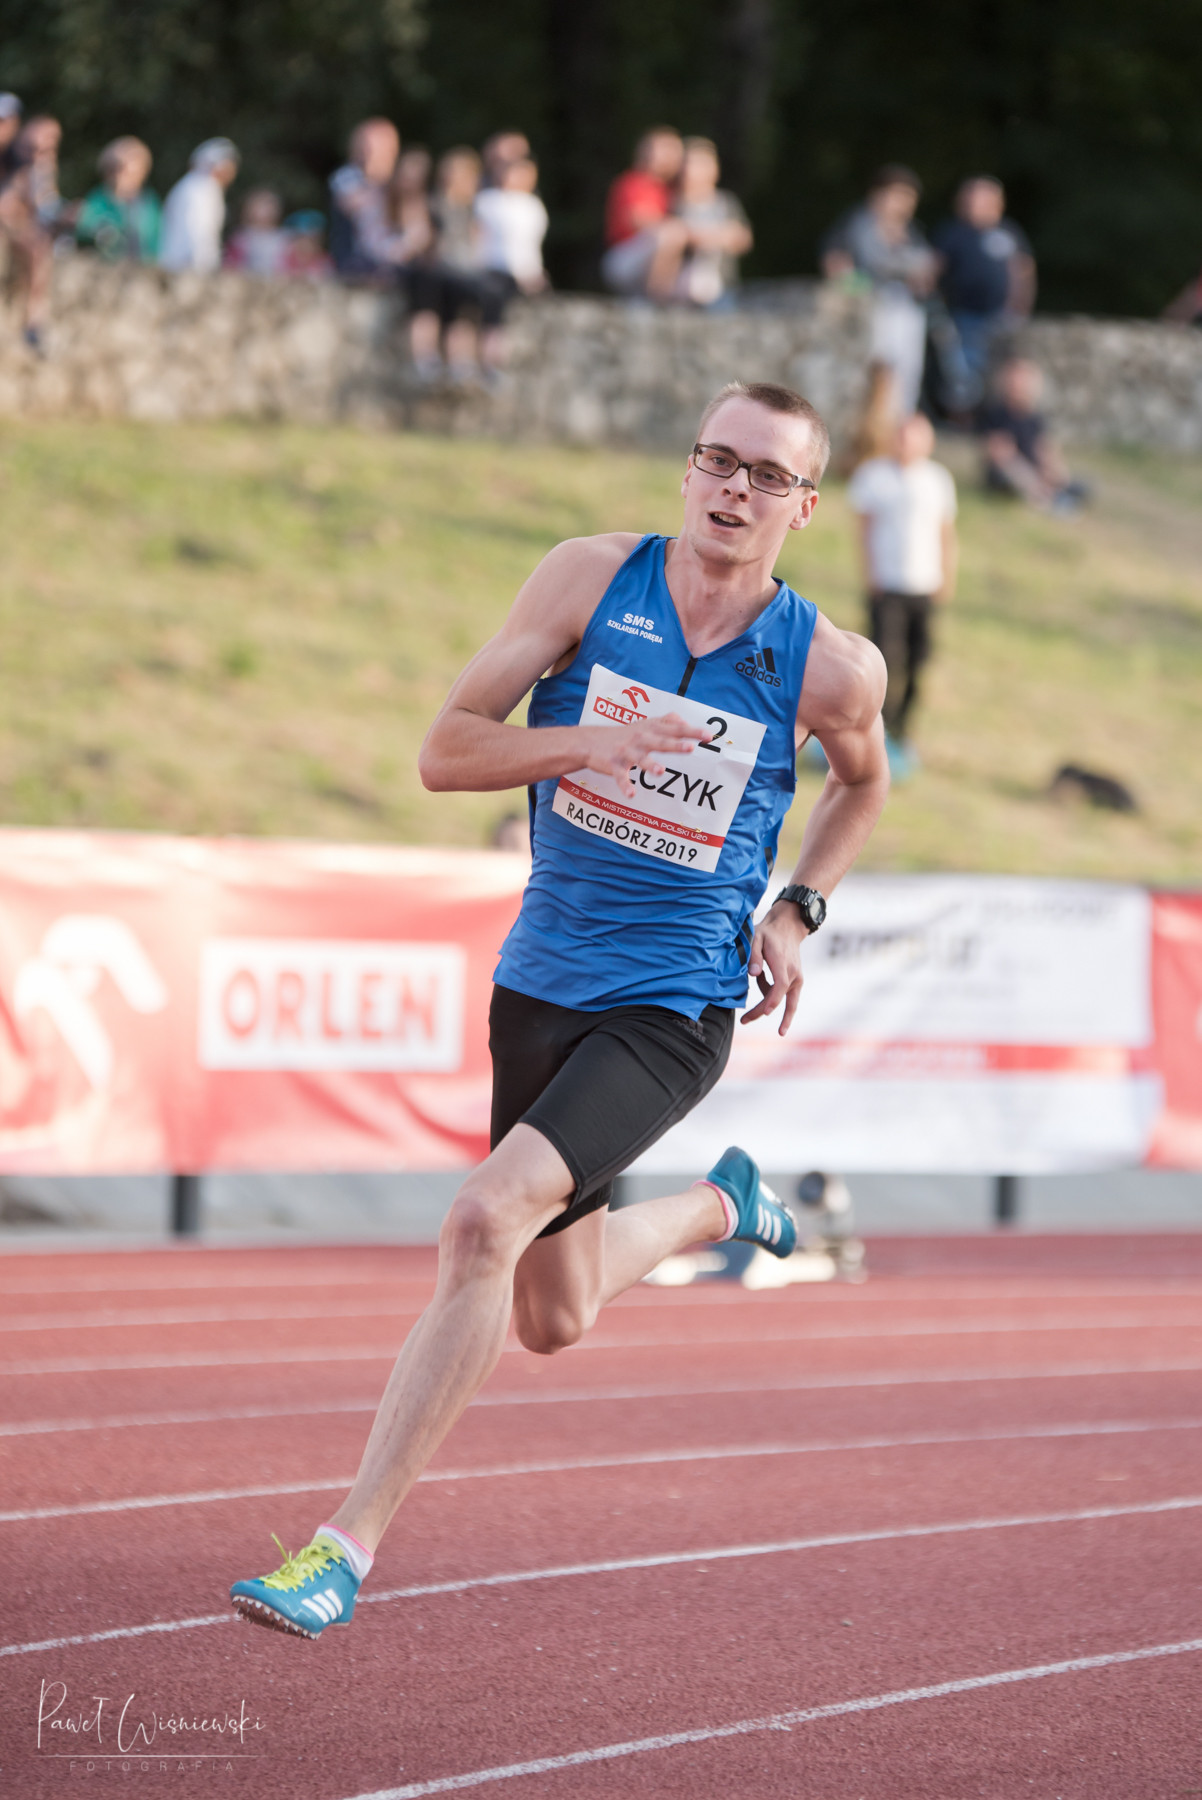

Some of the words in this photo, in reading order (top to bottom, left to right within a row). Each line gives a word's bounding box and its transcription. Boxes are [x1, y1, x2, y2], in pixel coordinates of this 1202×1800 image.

[607, 619, 639, 637] SZKLARSKA
[639, 629, 663, 644] PORĘBA
[622, 613, 655, 631] SMS
[735, 661, 782, 688] adidas
[566, 801, 652, 849] RACIBÓRZ
[653, 838, 698, 862] 2019
[581, 792, 600, 805] PZLA
[601, 801, 660, 827] MISTRZOSTWA
[660, 822, 690, 837] POLSKI
[690, 831, 708, 842] U20
[221, 968, 440, 1042] ORLEN
